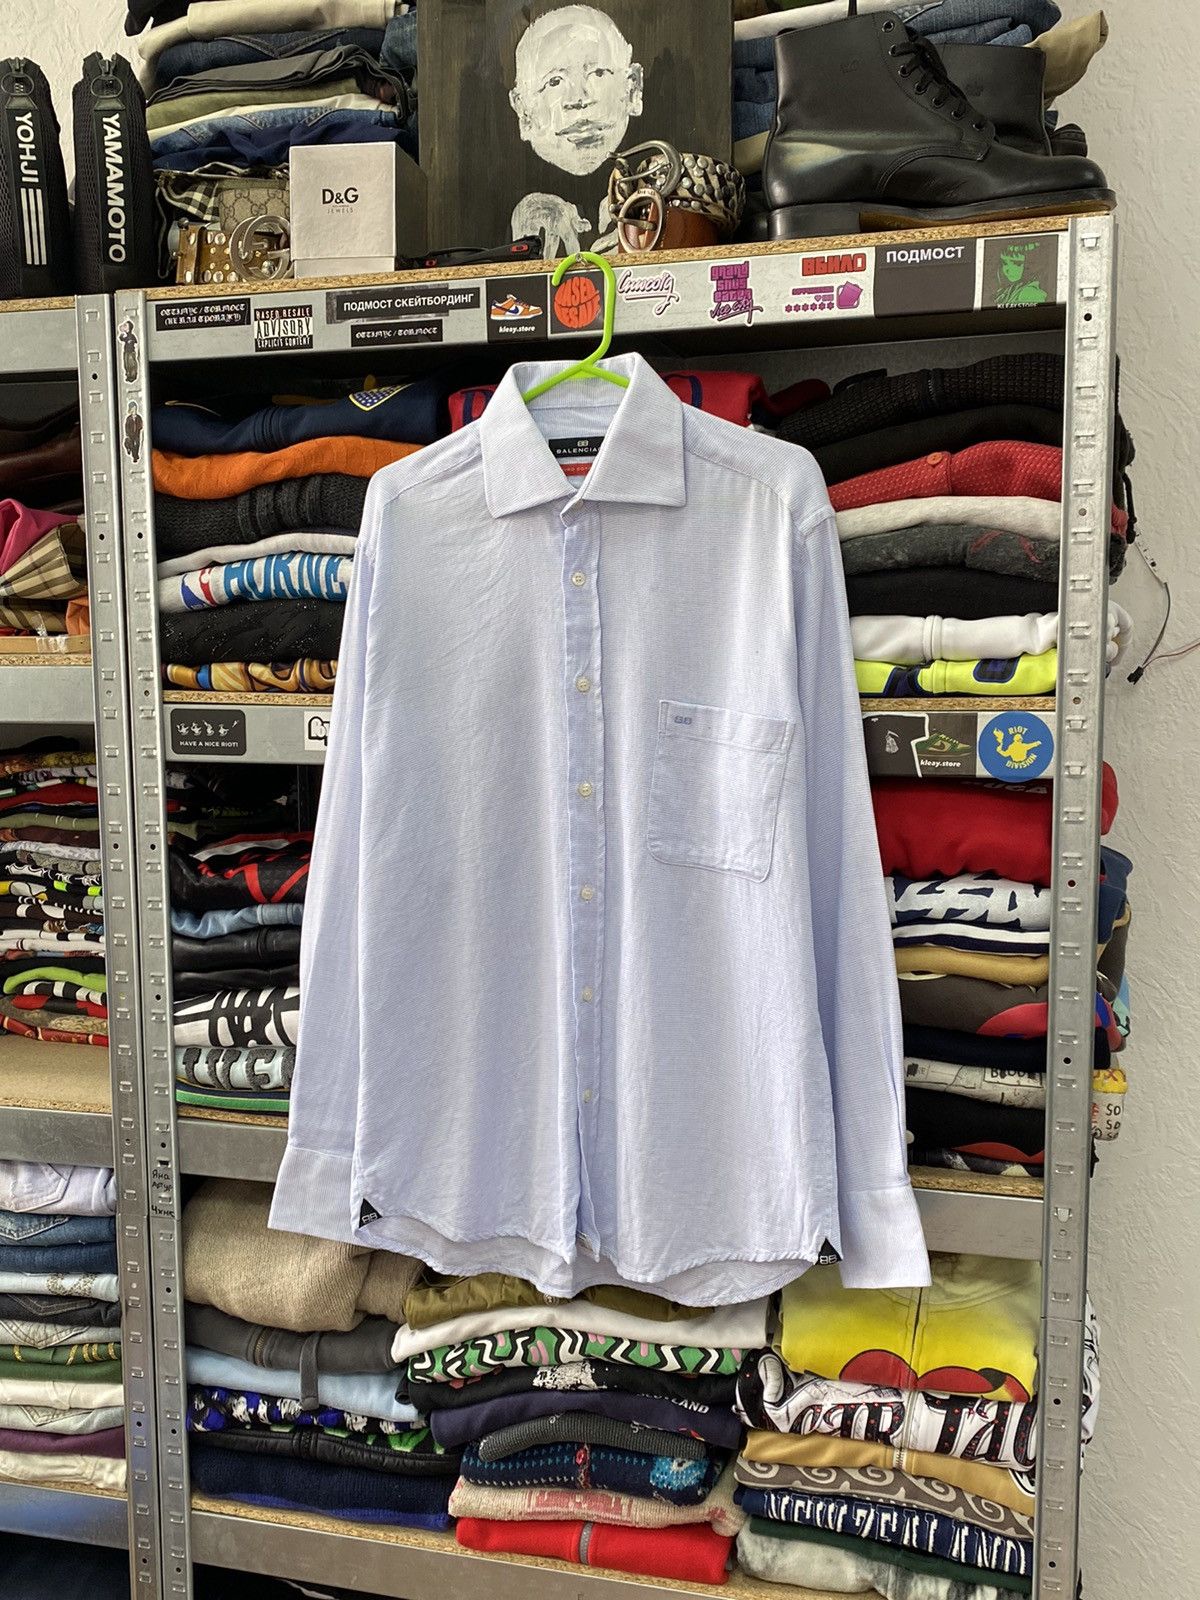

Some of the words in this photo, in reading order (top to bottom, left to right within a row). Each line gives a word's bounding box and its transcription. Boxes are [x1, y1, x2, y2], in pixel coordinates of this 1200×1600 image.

[15, 112, 39, 183] YOHJI
[102, 113, 126, 263] YAMAMOTO
[322, 187, 359, 205] D&G
[886, 246, 965, 263] ПОДМОСТ
[343, 299, 392, 312] ПОДМОСТ
[394, 293, 474, 308] СКЕЙТБОРДИНГ
[256, 317, 311, 340] ADVISORY
[1008, 726, 1028, 736] RIOT
[920, 759, 961, 768] kleay.store
[1005, 754, 1038, 769] DIVISION
